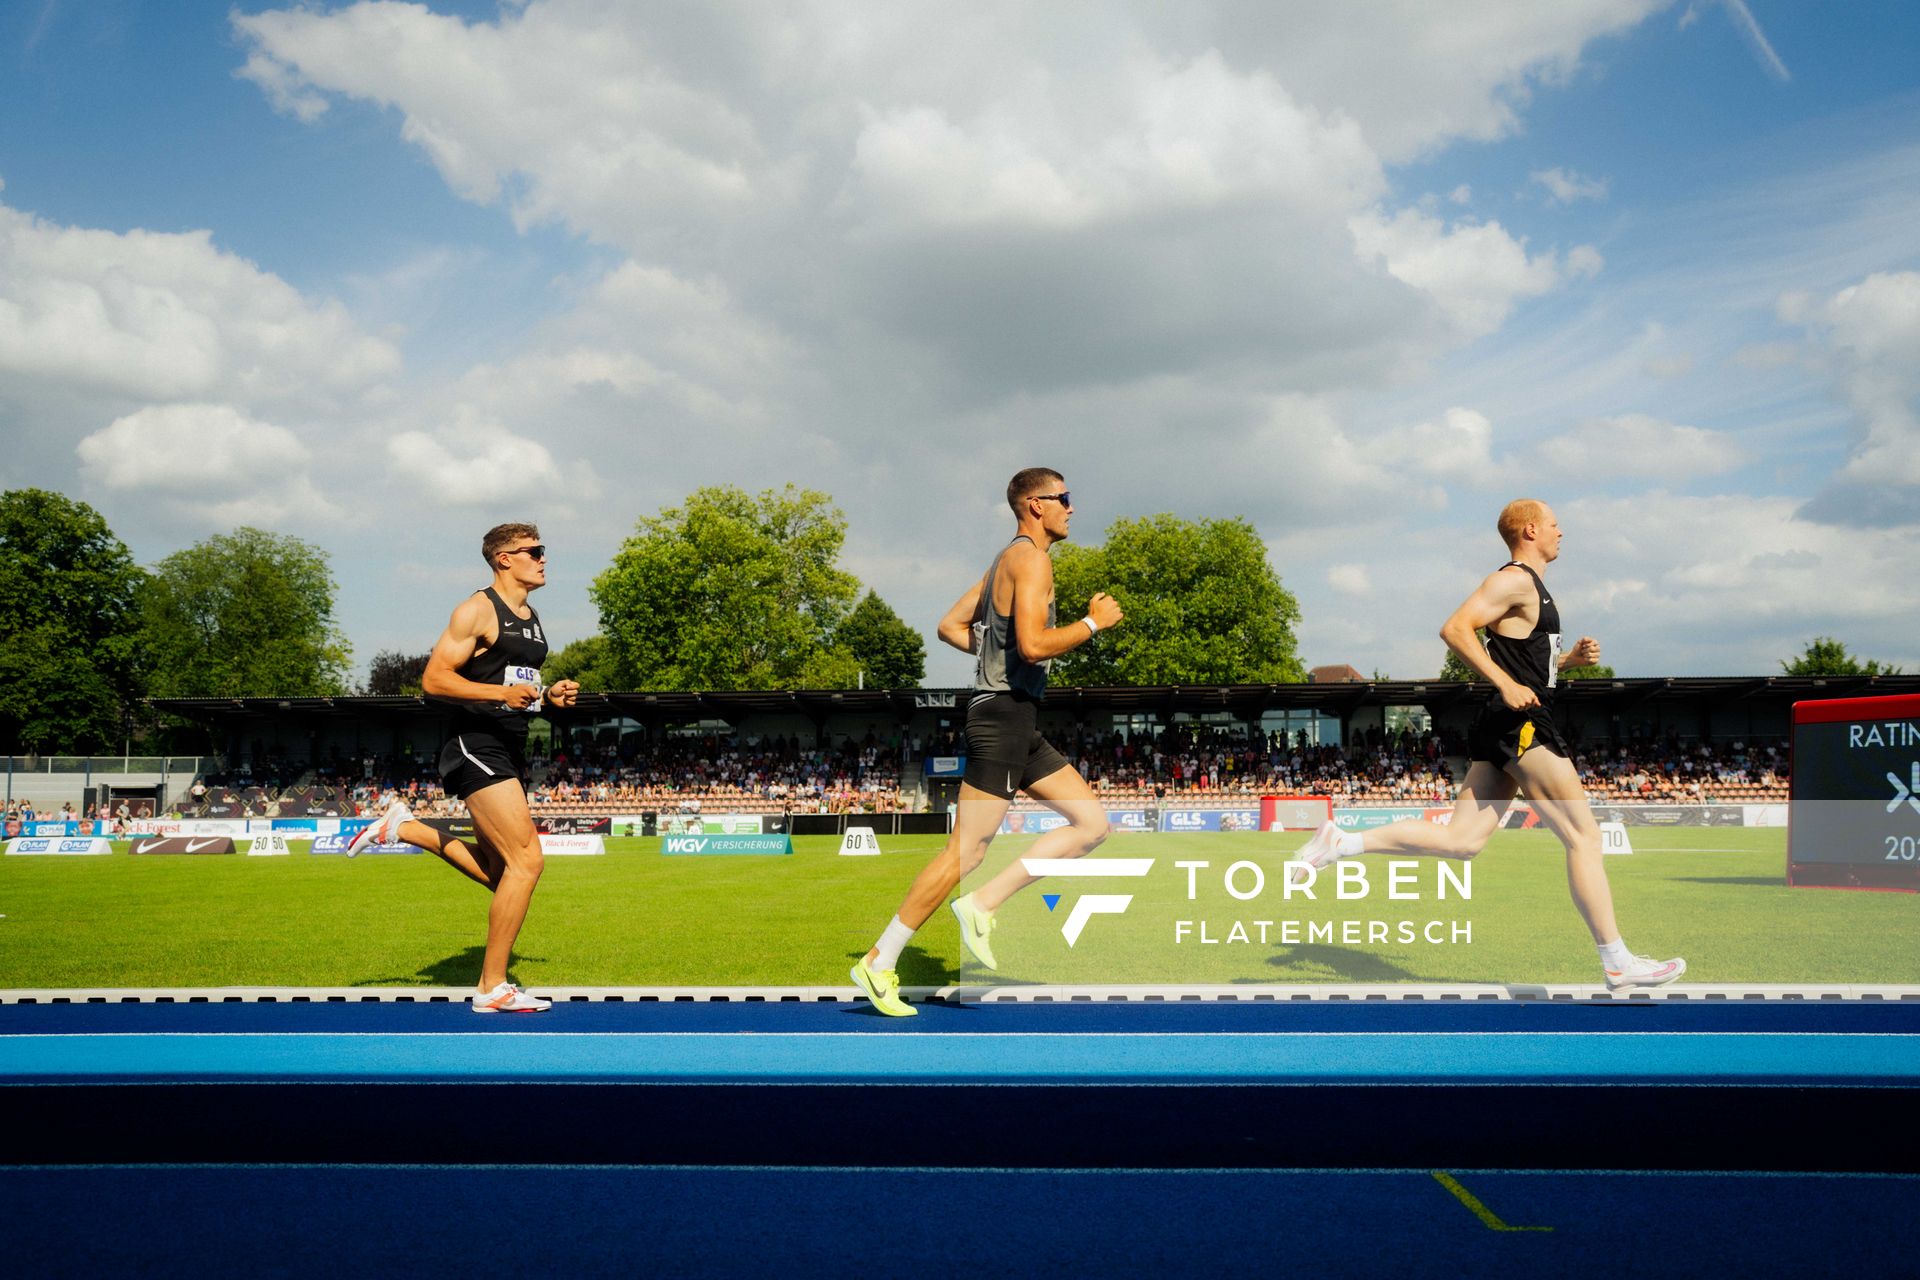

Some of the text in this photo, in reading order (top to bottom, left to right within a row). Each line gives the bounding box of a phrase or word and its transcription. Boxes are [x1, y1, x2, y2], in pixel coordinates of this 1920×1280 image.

[254, 836, 268, 850] 50
[272, 836, 285, 850] 50
[667, 838, 783, 853] WGV VERSICHERUNG
[846, 834, 862, 849] 60
[1885, 835, 1920, 861] 20
